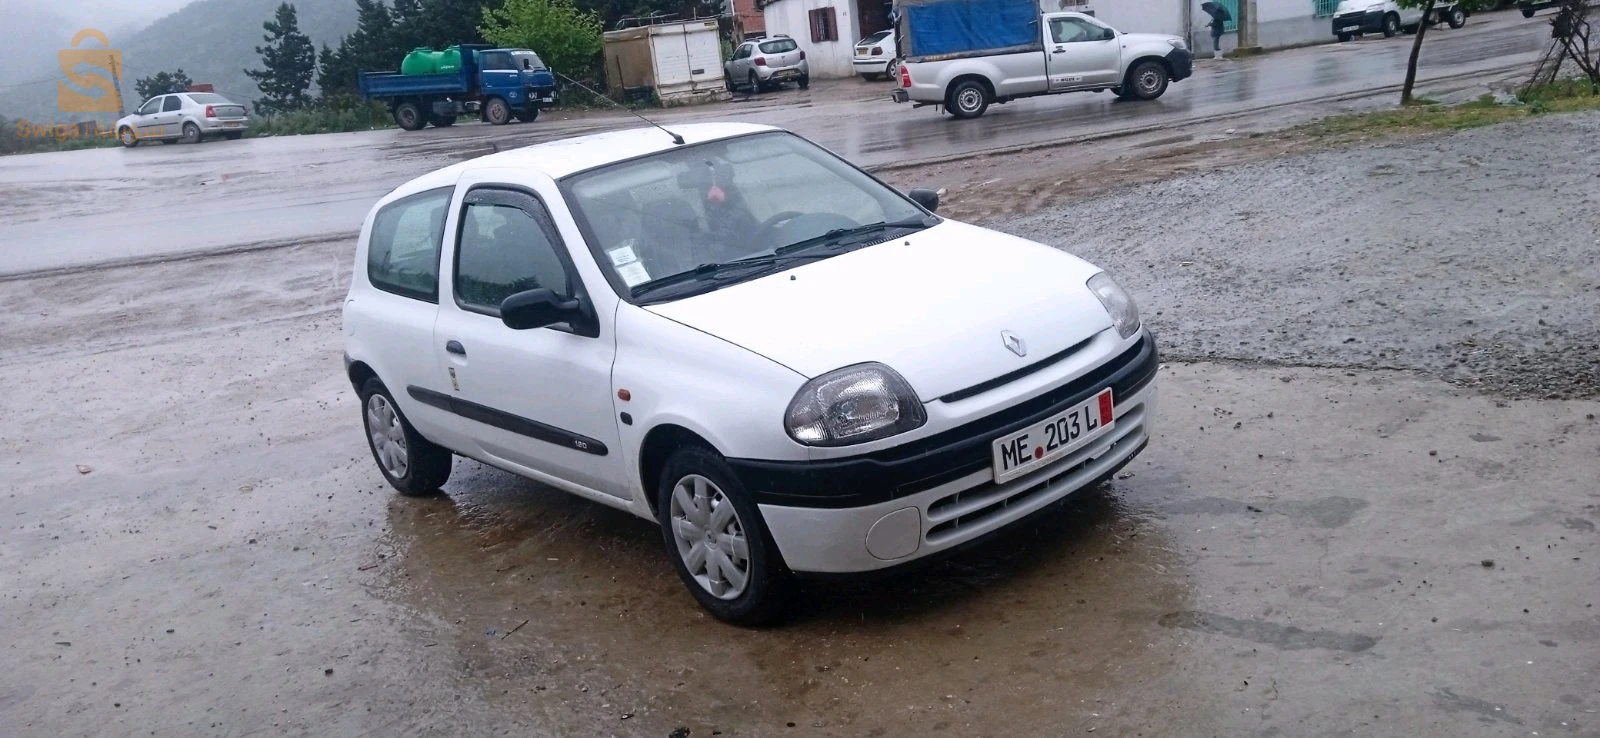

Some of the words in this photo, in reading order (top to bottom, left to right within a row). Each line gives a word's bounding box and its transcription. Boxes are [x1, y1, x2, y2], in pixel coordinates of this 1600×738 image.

[1001, 434, 1032, 470] ME
[1045, 411, 1080, 452] 203
[1085, 405, 1098, 432] L
